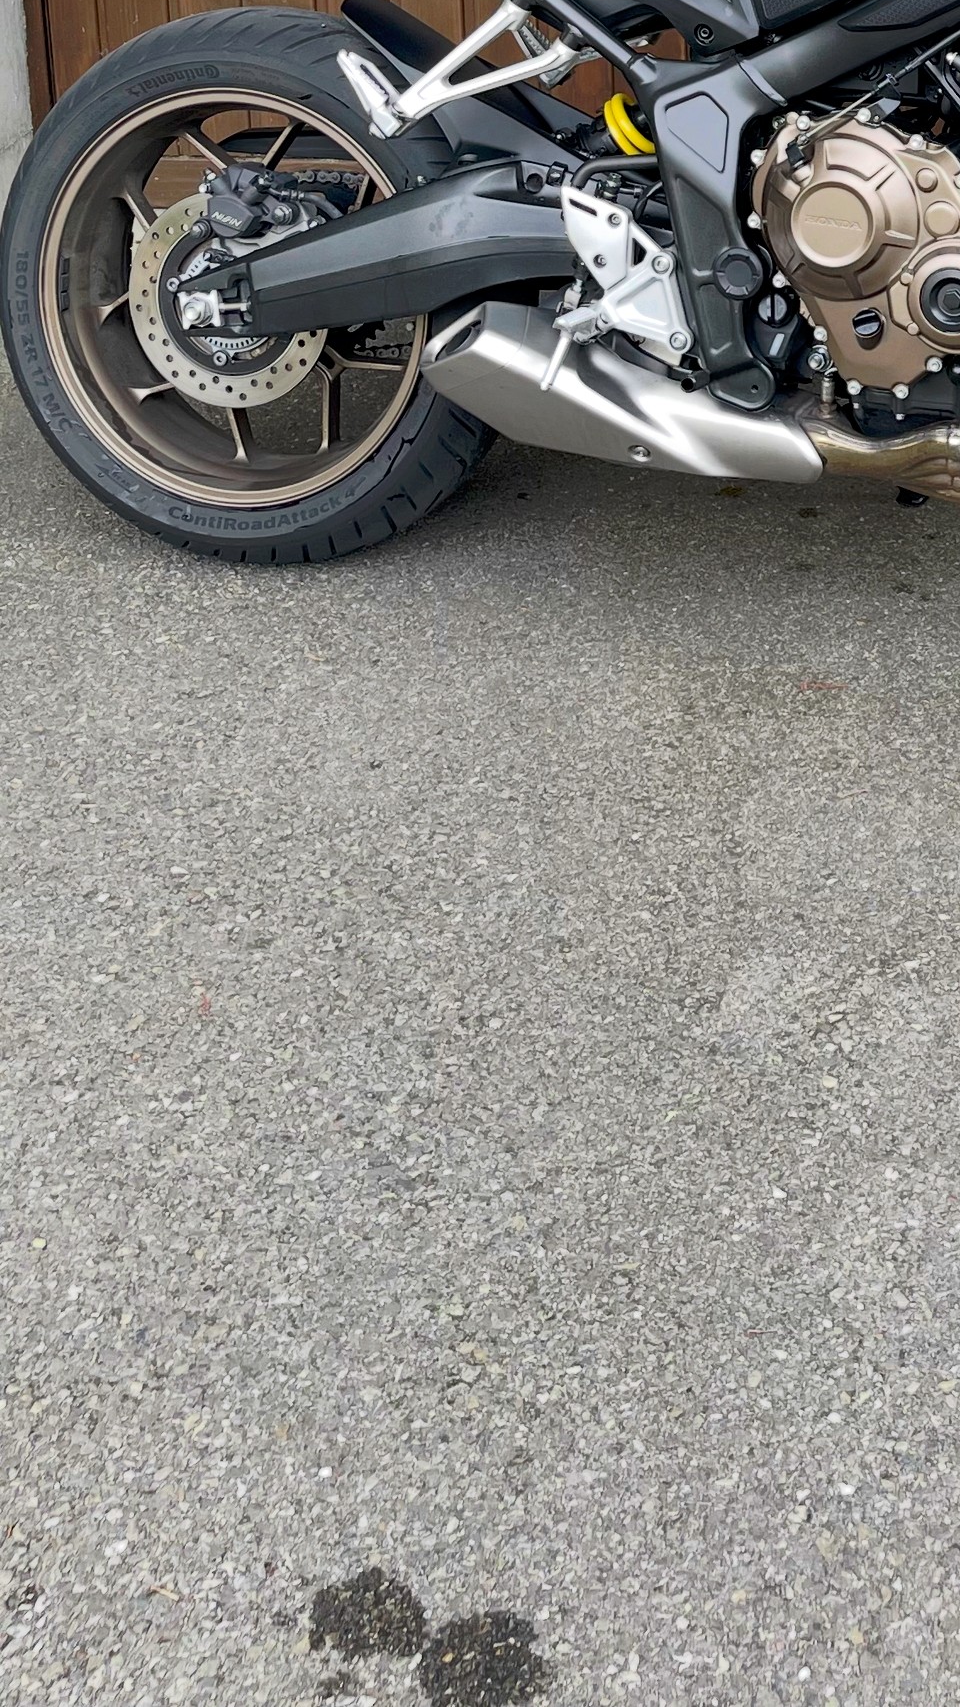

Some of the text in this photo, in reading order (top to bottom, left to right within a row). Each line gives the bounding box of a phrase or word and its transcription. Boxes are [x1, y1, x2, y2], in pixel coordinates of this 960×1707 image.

[142, 64, 220, 90] Continental
[804, 214, 863, 232] HONDA
[15, 250, 30, 327] 180/55
[168, 496, 341, 532] ContiRoadAttack
